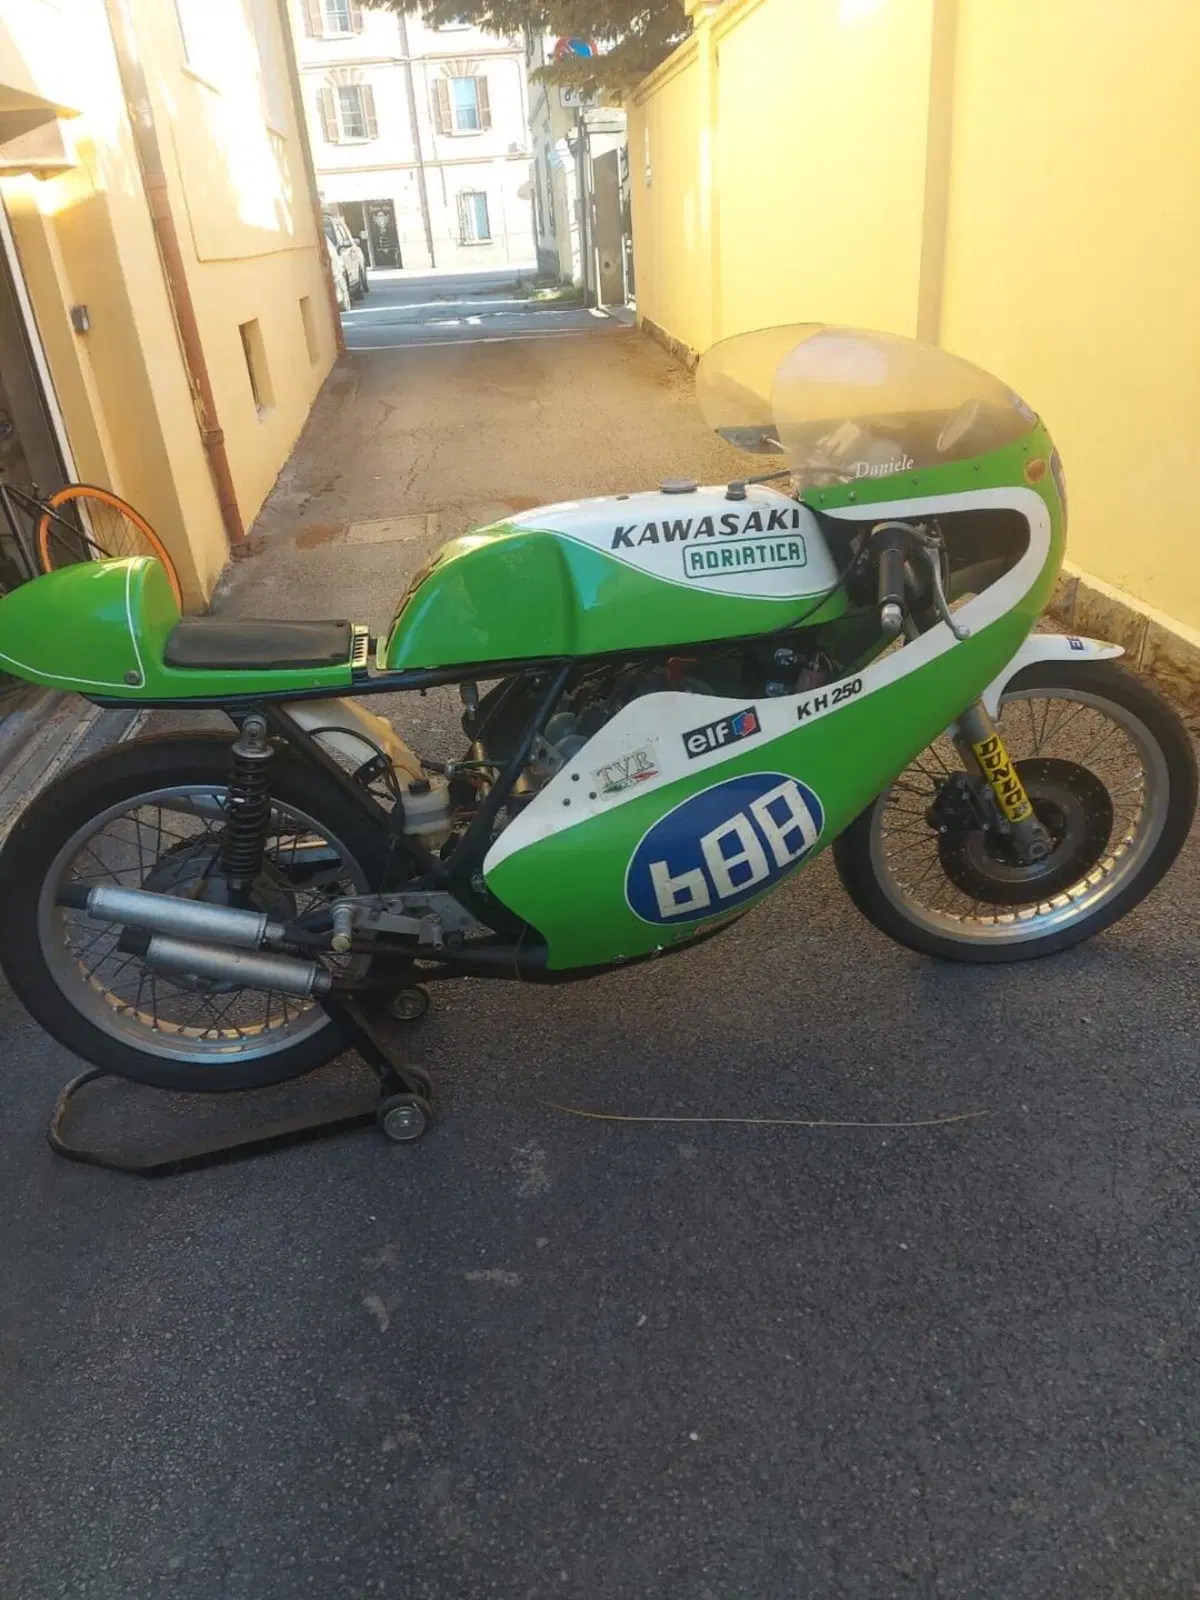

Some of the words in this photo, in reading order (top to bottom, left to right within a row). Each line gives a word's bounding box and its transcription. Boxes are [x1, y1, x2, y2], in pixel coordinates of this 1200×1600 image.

[854, 454, 914, 478] Daniele
[611, 508, 800, 550] KAWASAKI
[690, 541, 800, 571] ADRIATICA
[831, 678, 863, 705] 250
[687, 721, 730, 753] elf
[596, 750, 655, 787] TVR
[649, 779, 819, 918] 688
